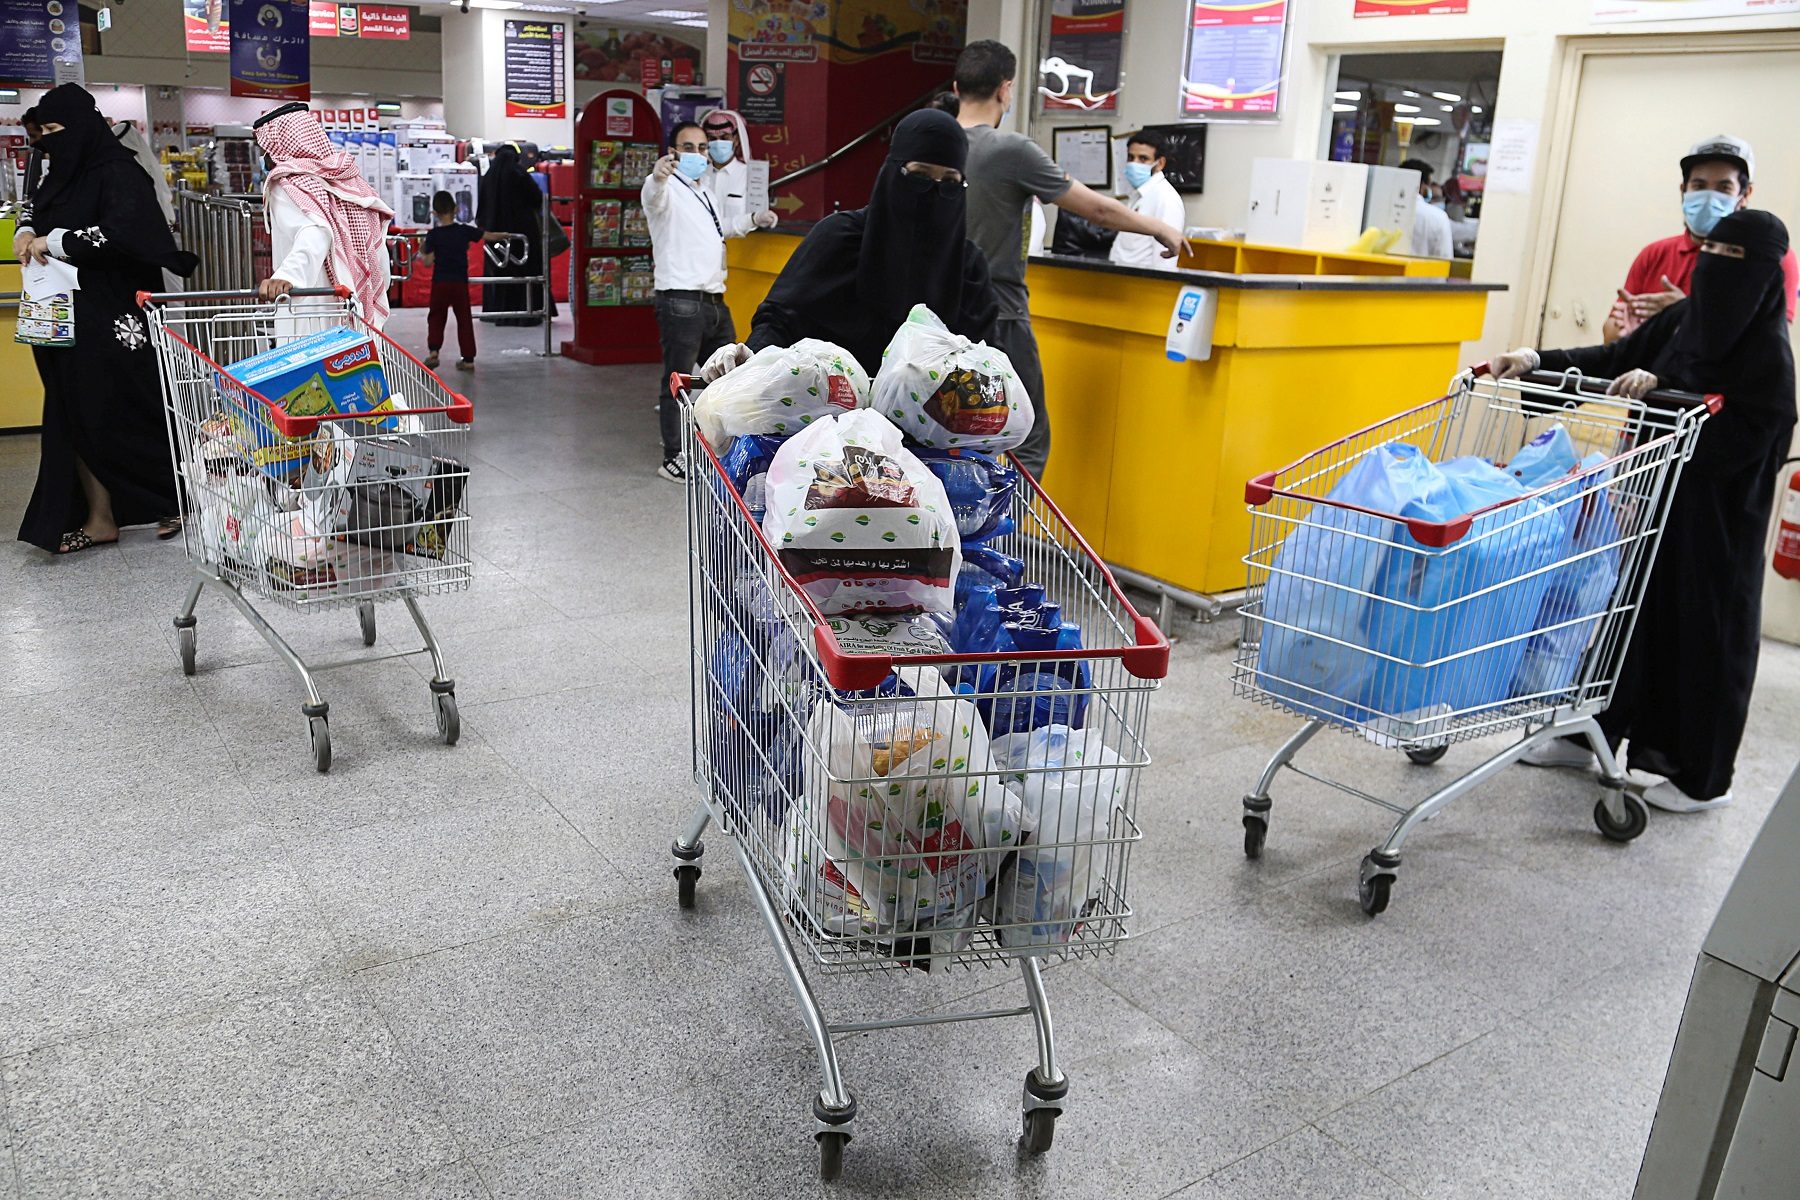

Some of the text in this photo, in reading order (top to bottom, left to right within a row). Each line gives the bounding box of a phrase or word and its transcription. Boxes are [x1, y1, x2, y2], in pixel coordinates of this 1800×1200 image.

[362, 12, 407, 22] الخدمة ذاتية
[395, 27, 408, 35] في
[330, 343, 371, 371] إندومي
